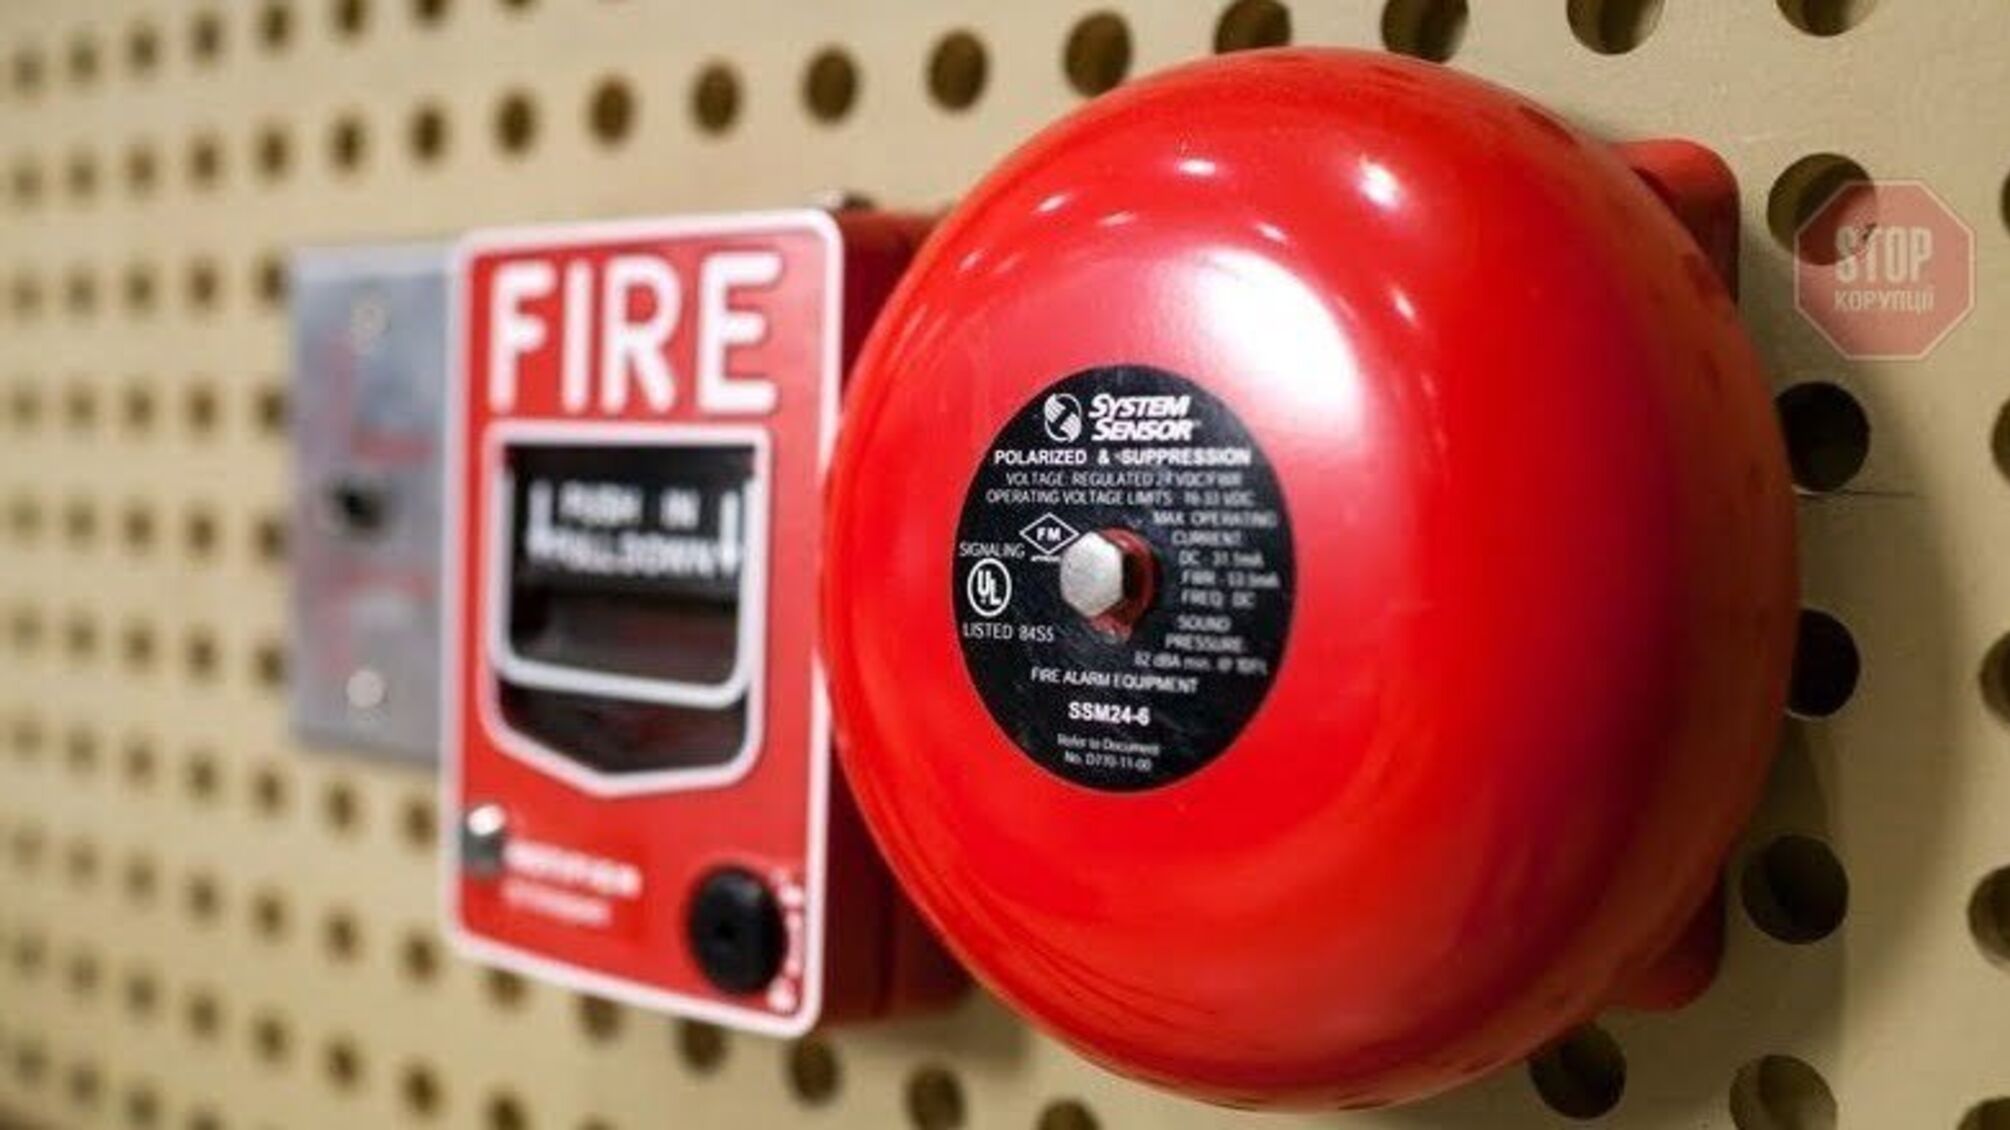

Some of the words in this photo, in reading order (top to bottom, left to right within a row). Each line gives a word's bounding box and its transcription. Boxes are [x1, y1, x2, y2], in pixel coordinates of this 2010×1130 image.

[486, 251, 784, 415] FIRE
[1088, 393, 1191, 418] SYSTEM
[1091, 418, 1195, 441] SENSOR
[994, 449, 1087, 466] POLARIZED
[1097, 449, 1110, 465] &
[1120, 449, 1251, 467] SUPPRESSION
[1071, 471, 1150, 487] REGULATED
[985, 488, 1060, 505] OPERATING
[1063, 488, 1124, 505] VOLTAGE
[1036, 527, 1061, 541] FM
[959, 541, 1026, 561] SIGNALING
[976, 570, 1002, 605] UL
[962, 622, 1012, 640] LISTED
[1177, 615, 1231, 632] SOUND
[1031, 667, 1060, 683] FIRE
[1063, 670, 1110, 687] ALARM
[1113, 673, 1198, 694] EQUIPMENT
[1068, 701, 1151, 726] SSM24-6
[1103, 738, 1161, 756] Document
